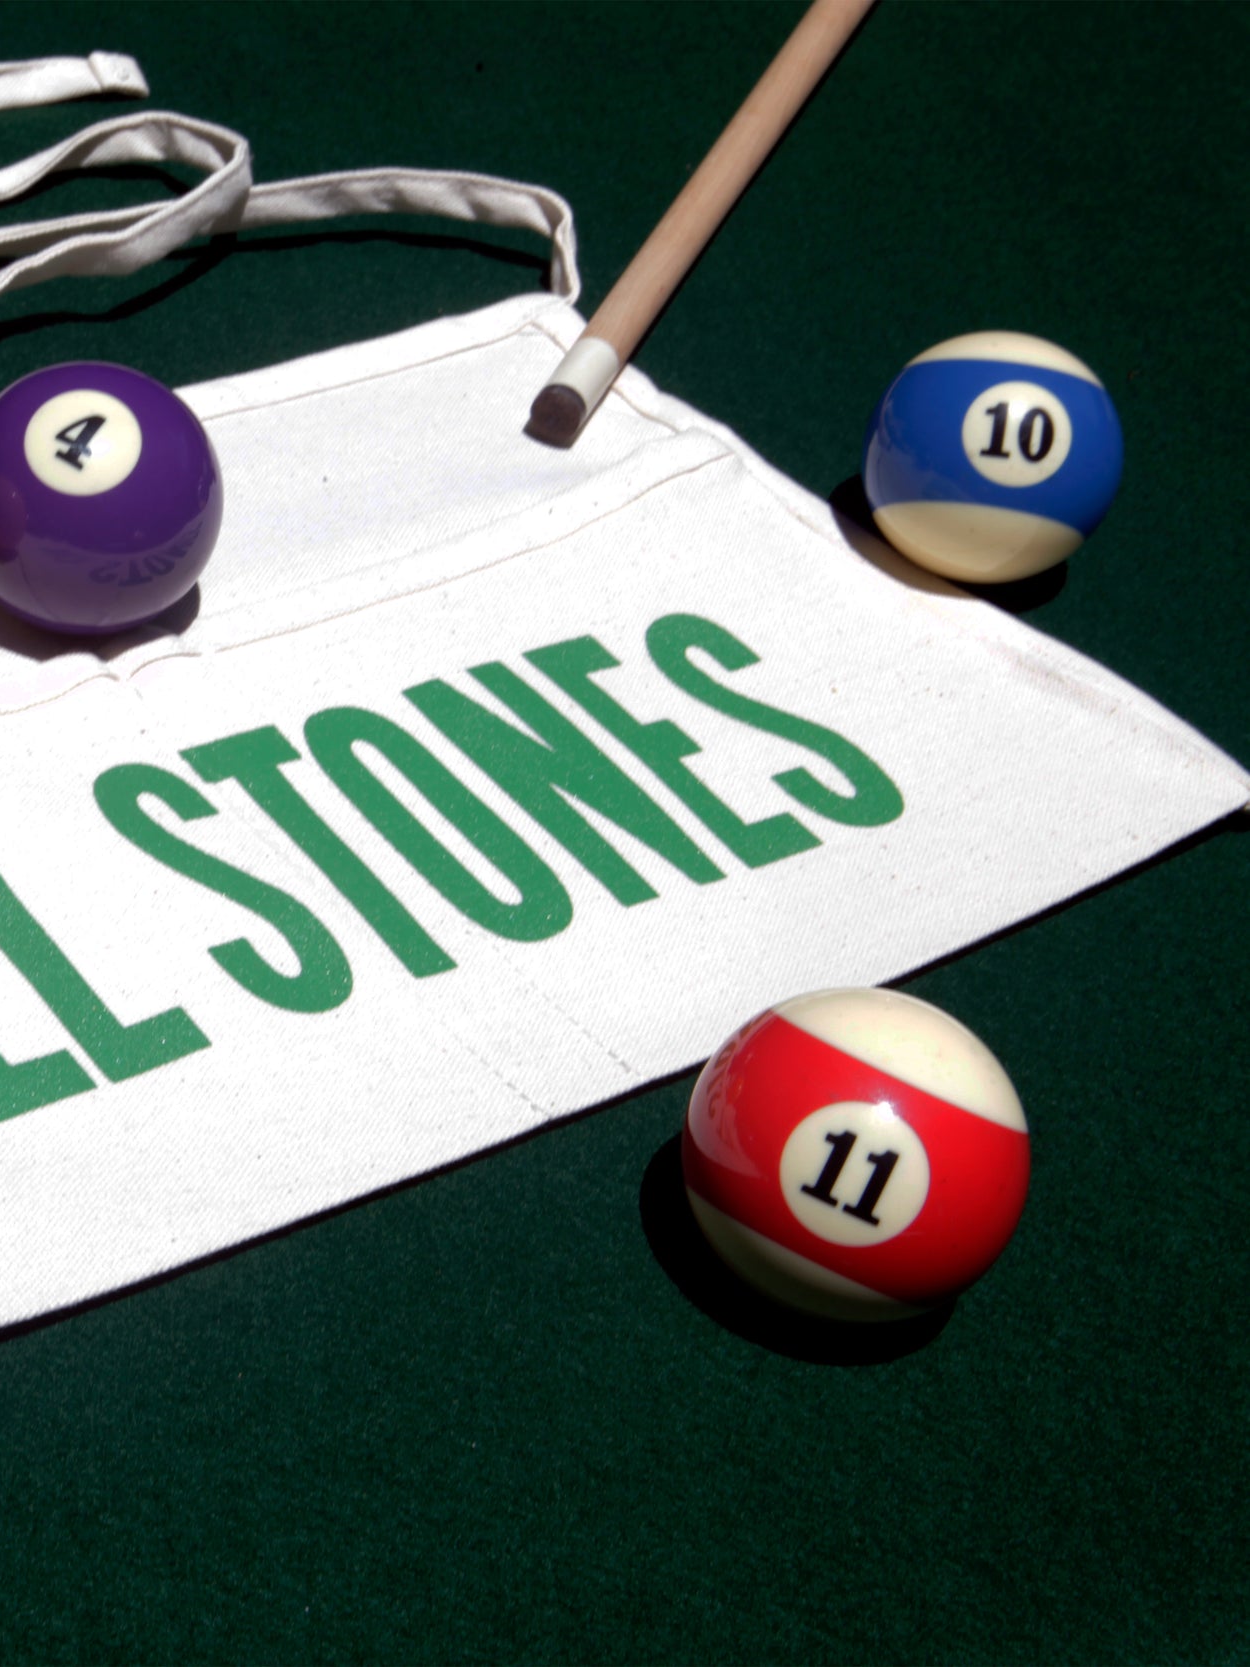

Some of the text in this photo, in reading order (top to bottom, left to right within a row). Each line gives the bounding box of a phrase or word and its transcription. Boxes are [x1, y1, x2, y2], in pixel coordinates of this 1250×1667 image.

[54, 414, 107, 471] 4
[980, 401, 1055, 462] 10
[95, 615, 903, 1013] STONES
[801, 1130, 899, 1227] 11
